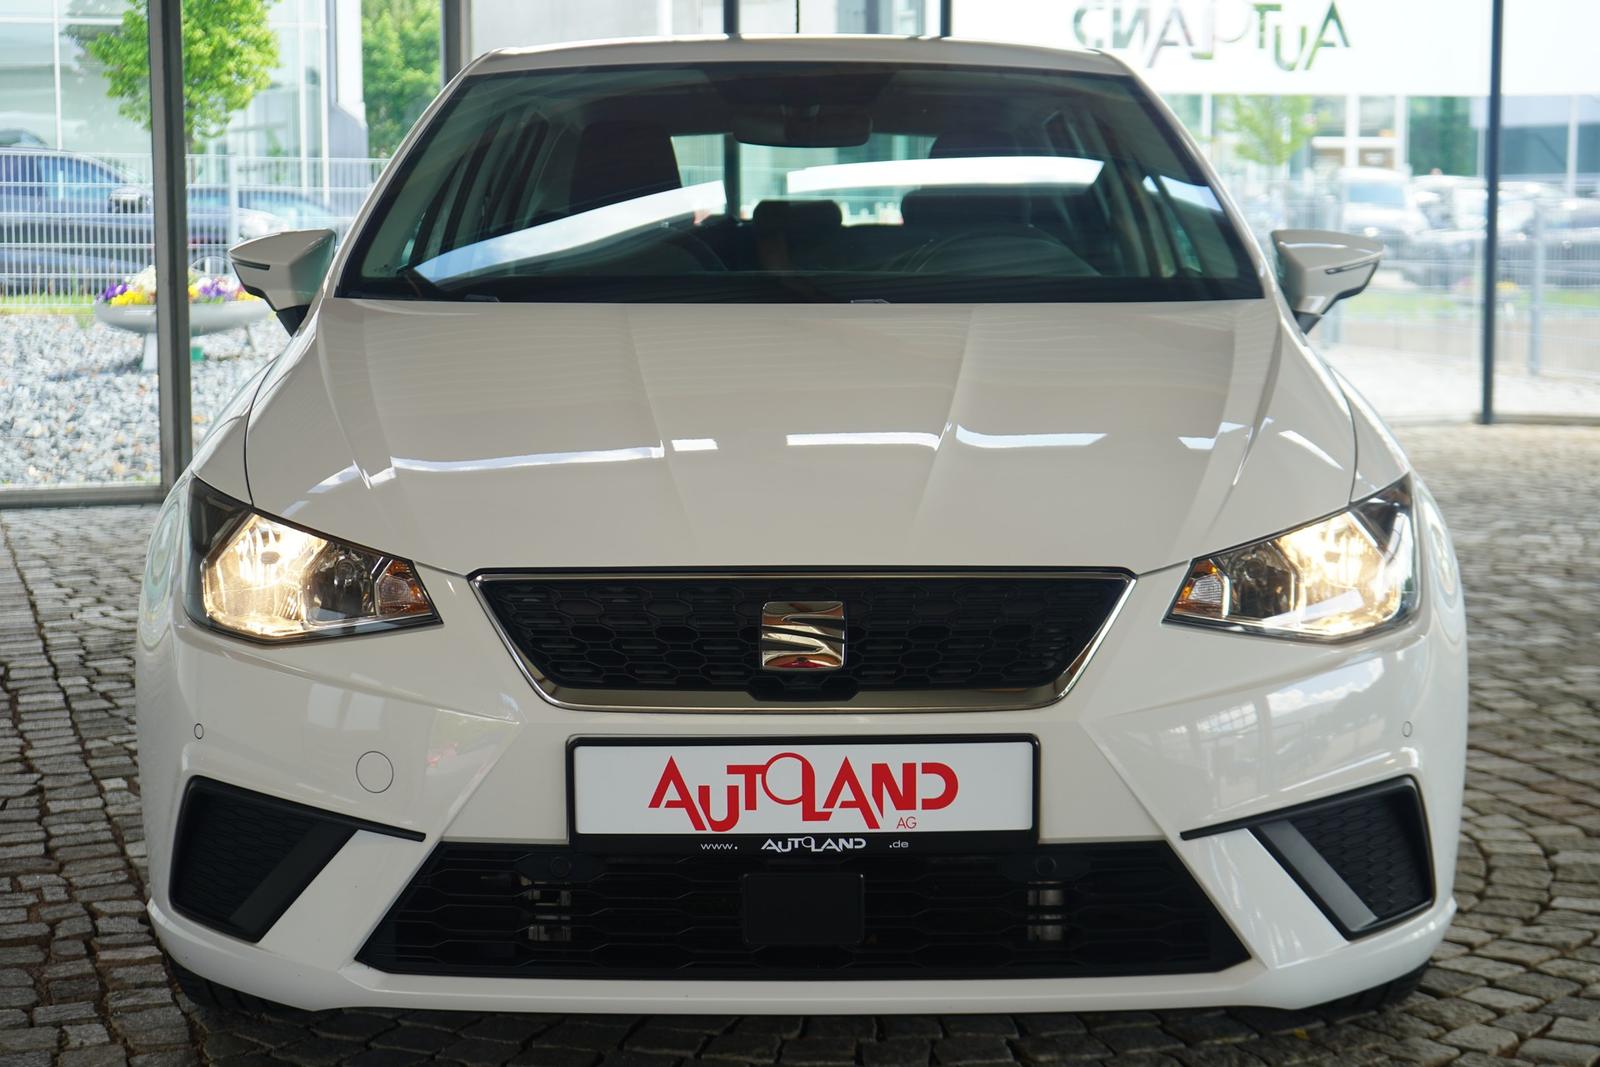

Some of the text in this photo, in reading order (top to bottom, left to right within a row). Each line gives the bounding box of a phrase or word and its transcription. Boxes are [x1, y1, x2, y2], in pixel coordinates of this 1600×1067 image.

[648, 751, 959, 832] AUTOLAND
[895, 816, 918, 830] AG
[760, 836, 867, 853] AUTOLAND
[889, 840, 909, 849] .de
